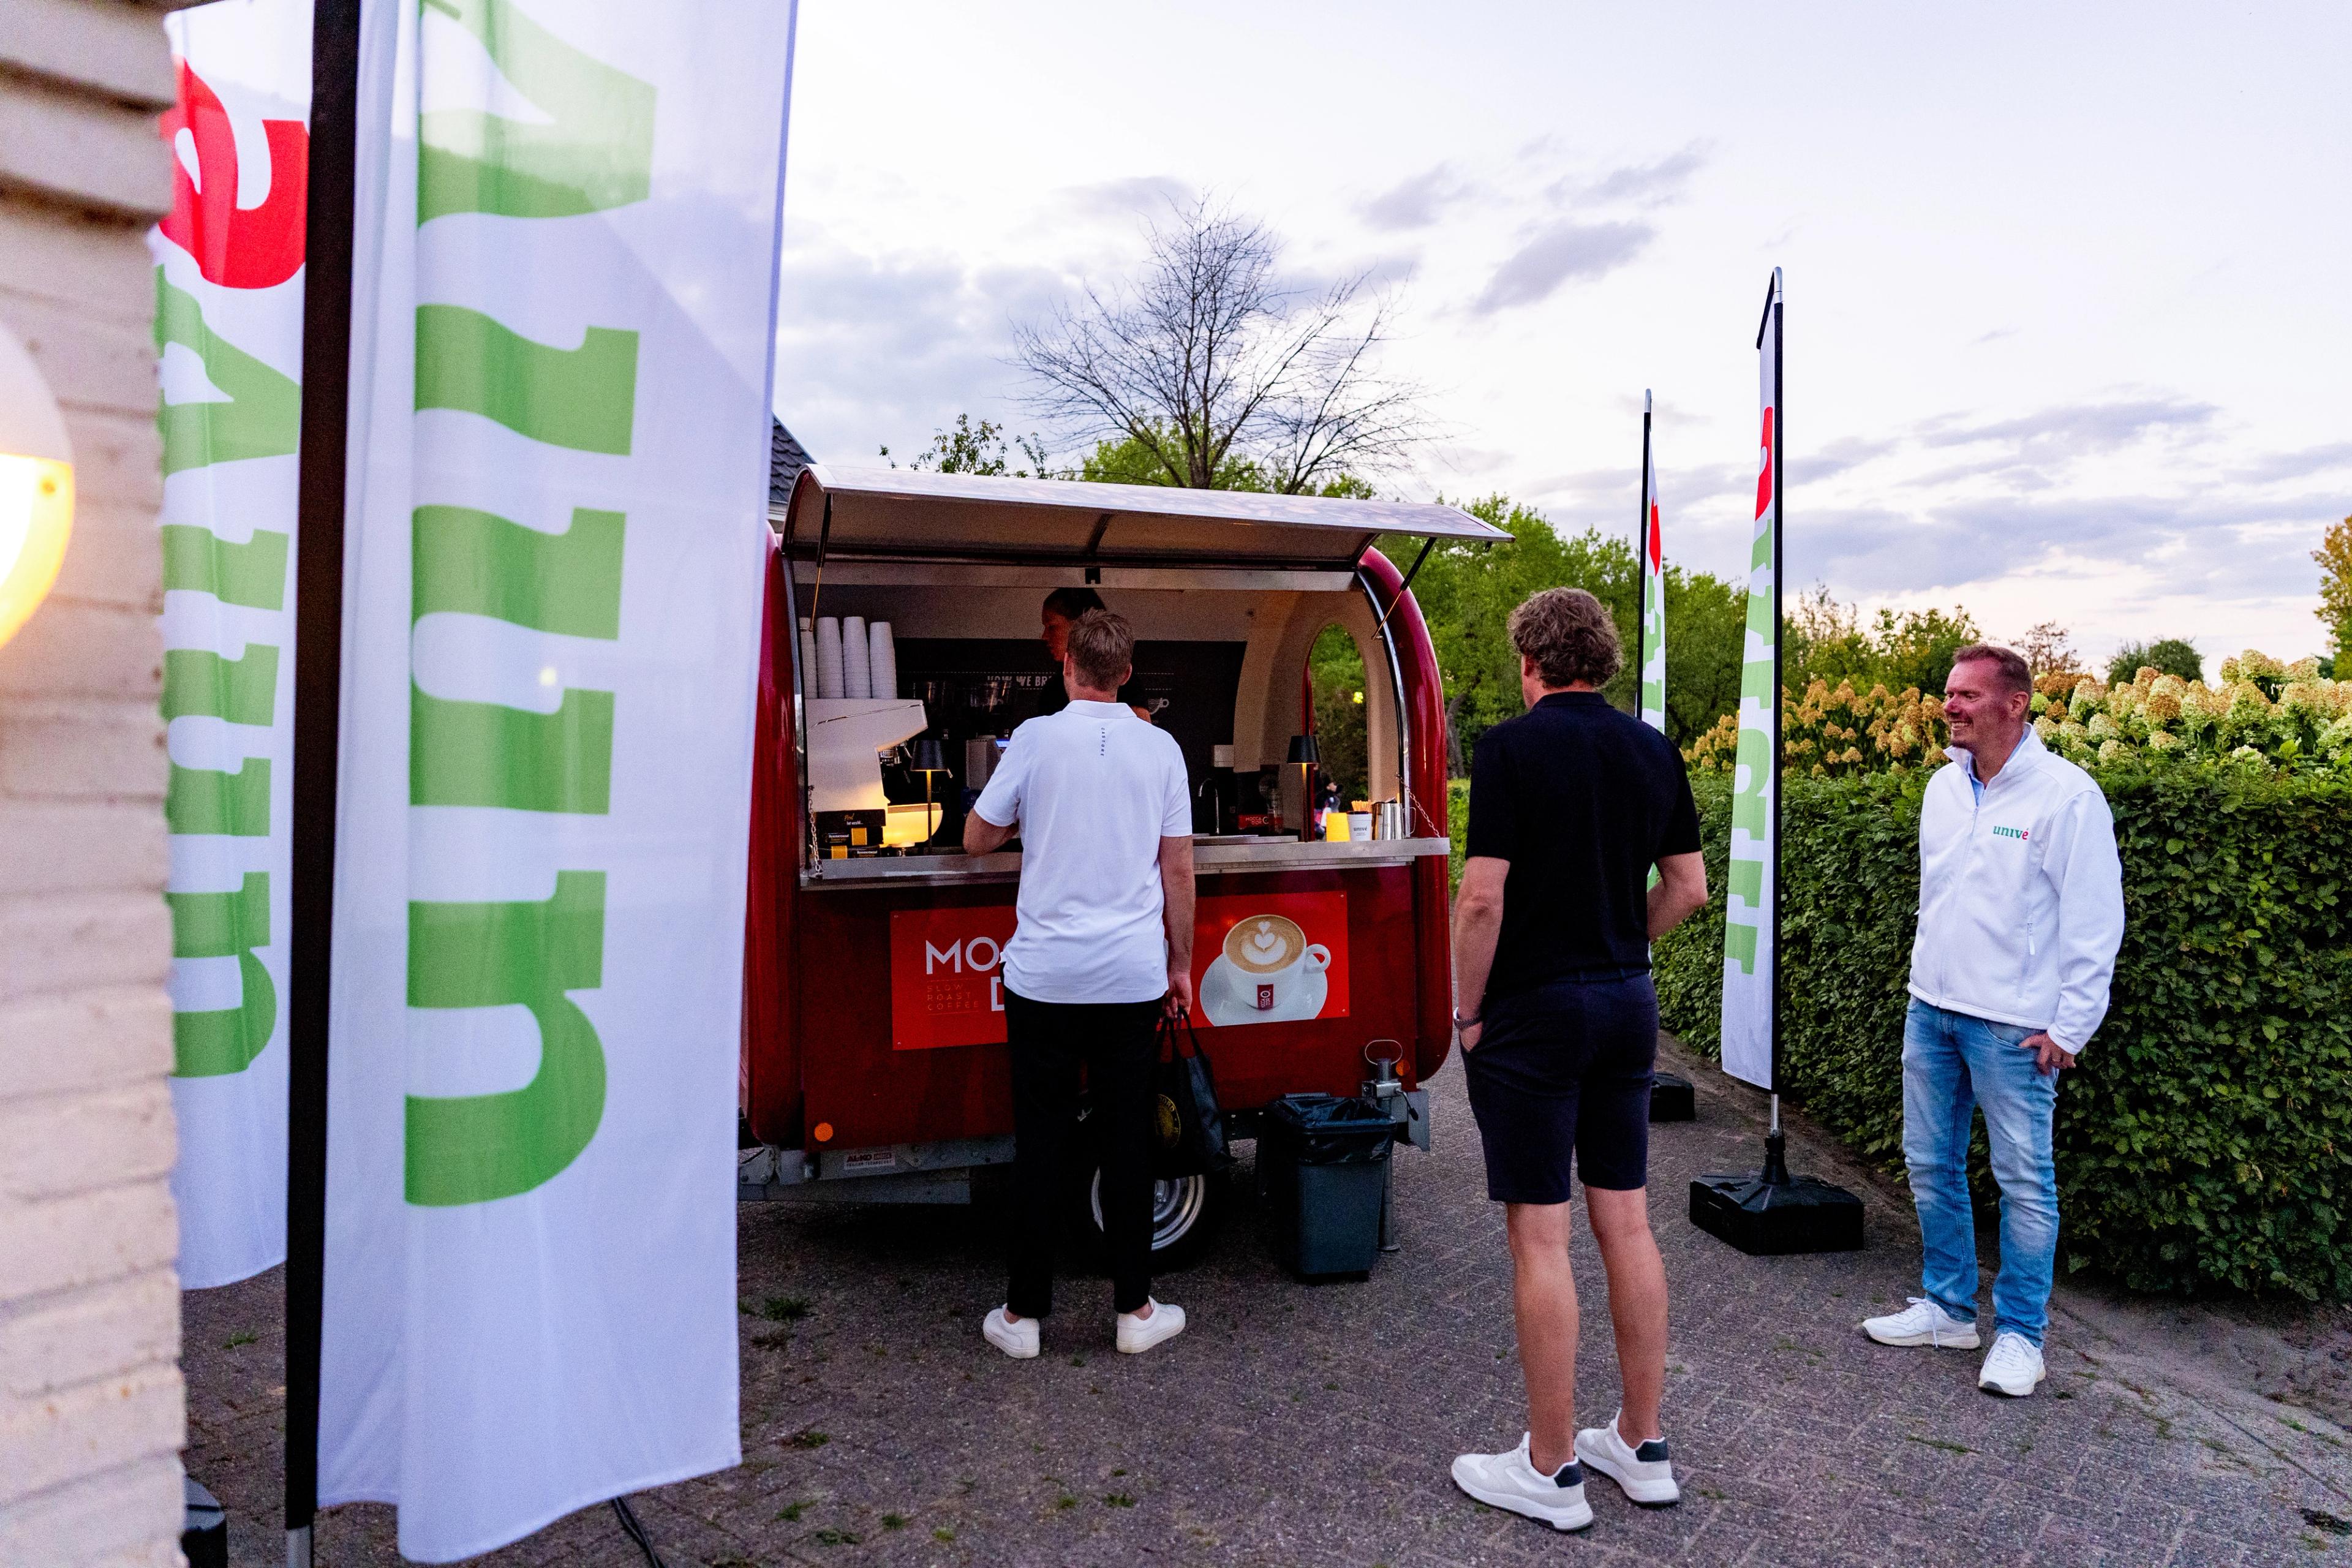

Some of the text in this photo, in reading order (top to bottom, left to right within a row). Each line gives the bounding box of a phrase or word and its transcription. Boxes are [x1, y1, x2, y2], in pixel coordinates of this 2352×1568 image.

[1016, 676, 1031, 687] WE
[1035, 676, 1052, 687] BR
[1993, 825, 2029, 840] univé
[925, 937, 1012, 974] MO
[927, 984, 963, 992] SLOW
[927, 992, 970, 1001] ROAST
[927, 1001, 979, 1011] COFFEE
